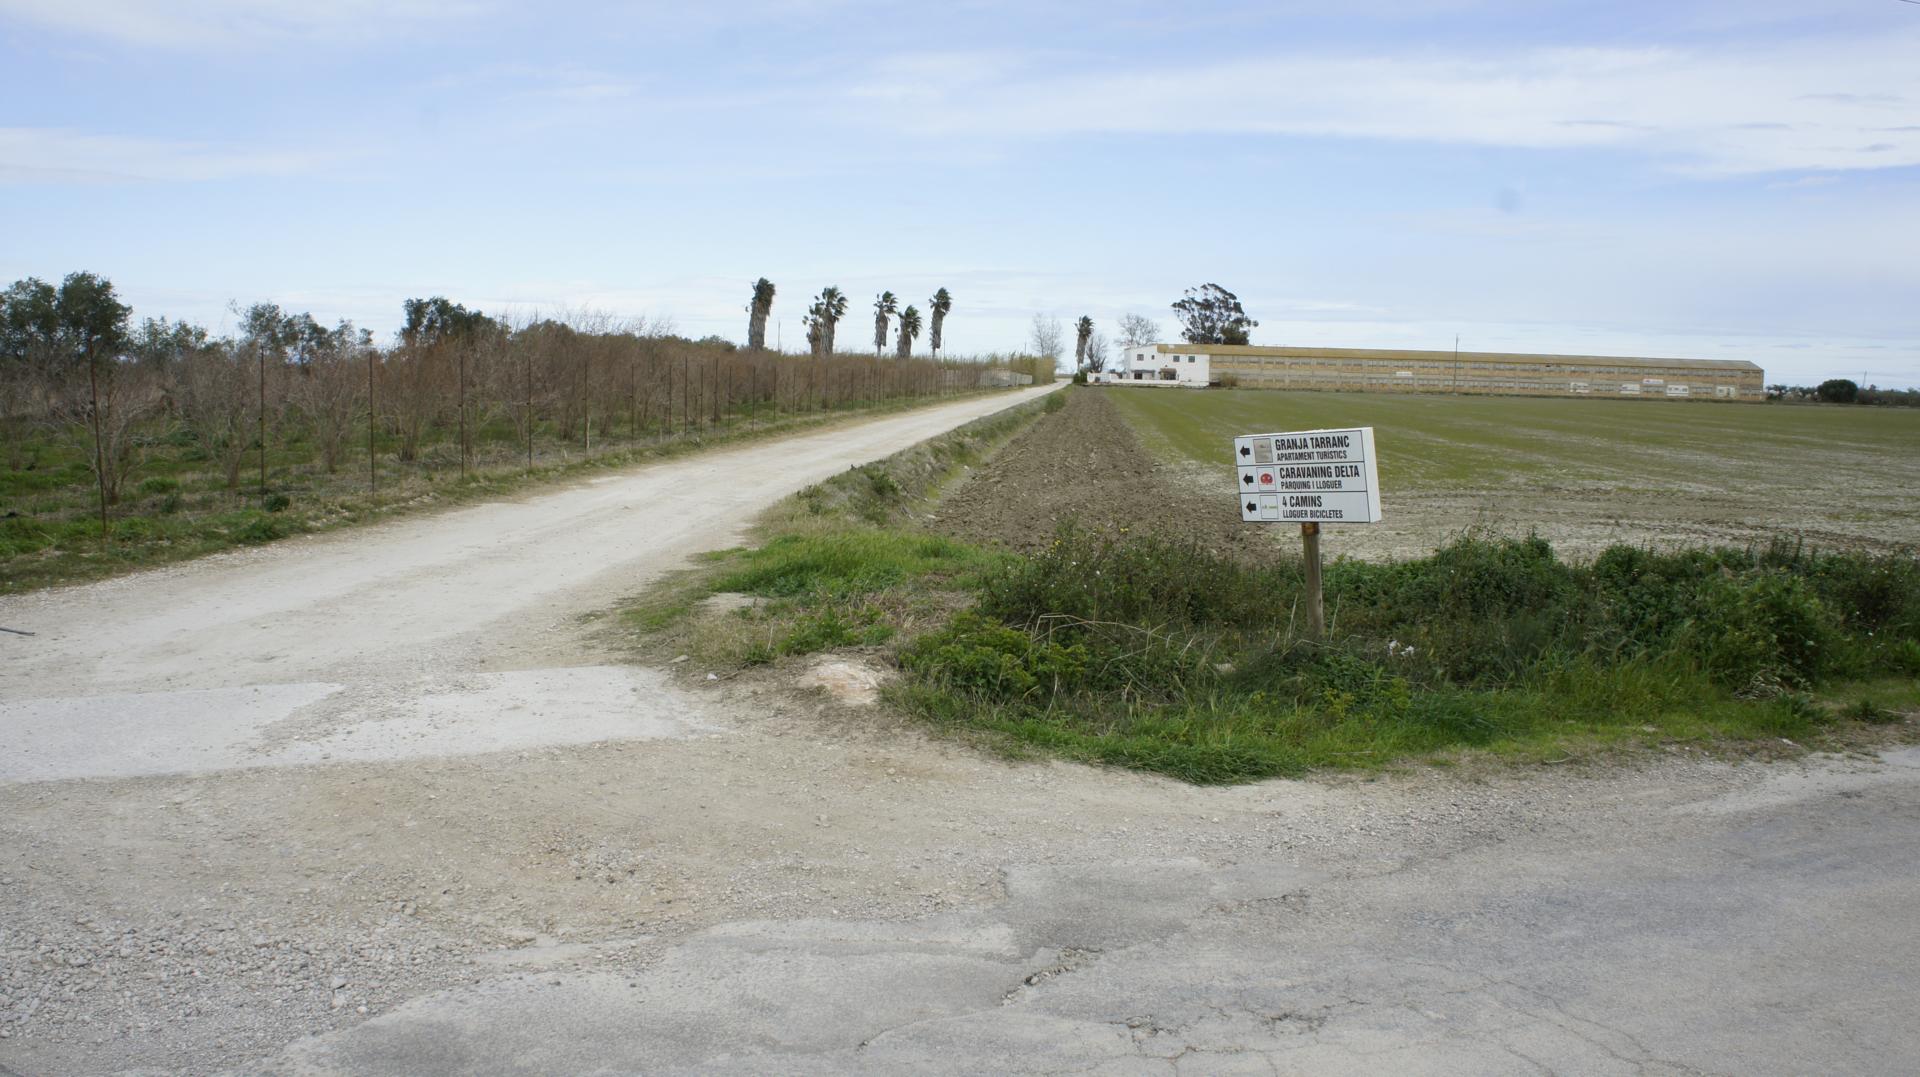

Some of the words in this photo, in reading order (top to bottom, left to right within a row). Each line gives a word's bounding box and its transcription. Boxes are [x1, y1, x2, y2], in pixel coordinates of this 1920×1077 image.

[1275, 437, 1309, 450] GRANJA
[1310, 436, 1349, 449] TARRANC
[1277, 452, 1314, 461] APARTAMENT
[1280, 466, 1332, 479] CARAVANING
[1335, 465, 1360, 477] DELTA
[1281, 481, 1311, 490] PARQUING
[1316, 480, 1342, 489] LLOGUER
[1282, 496, 1287, 507] 4
[1290, 496, 1322, 507] CAMINS
[1283, 510, 1308, 518] LLOGUER
[1310, 510, 1343, 518] BICICLETES
